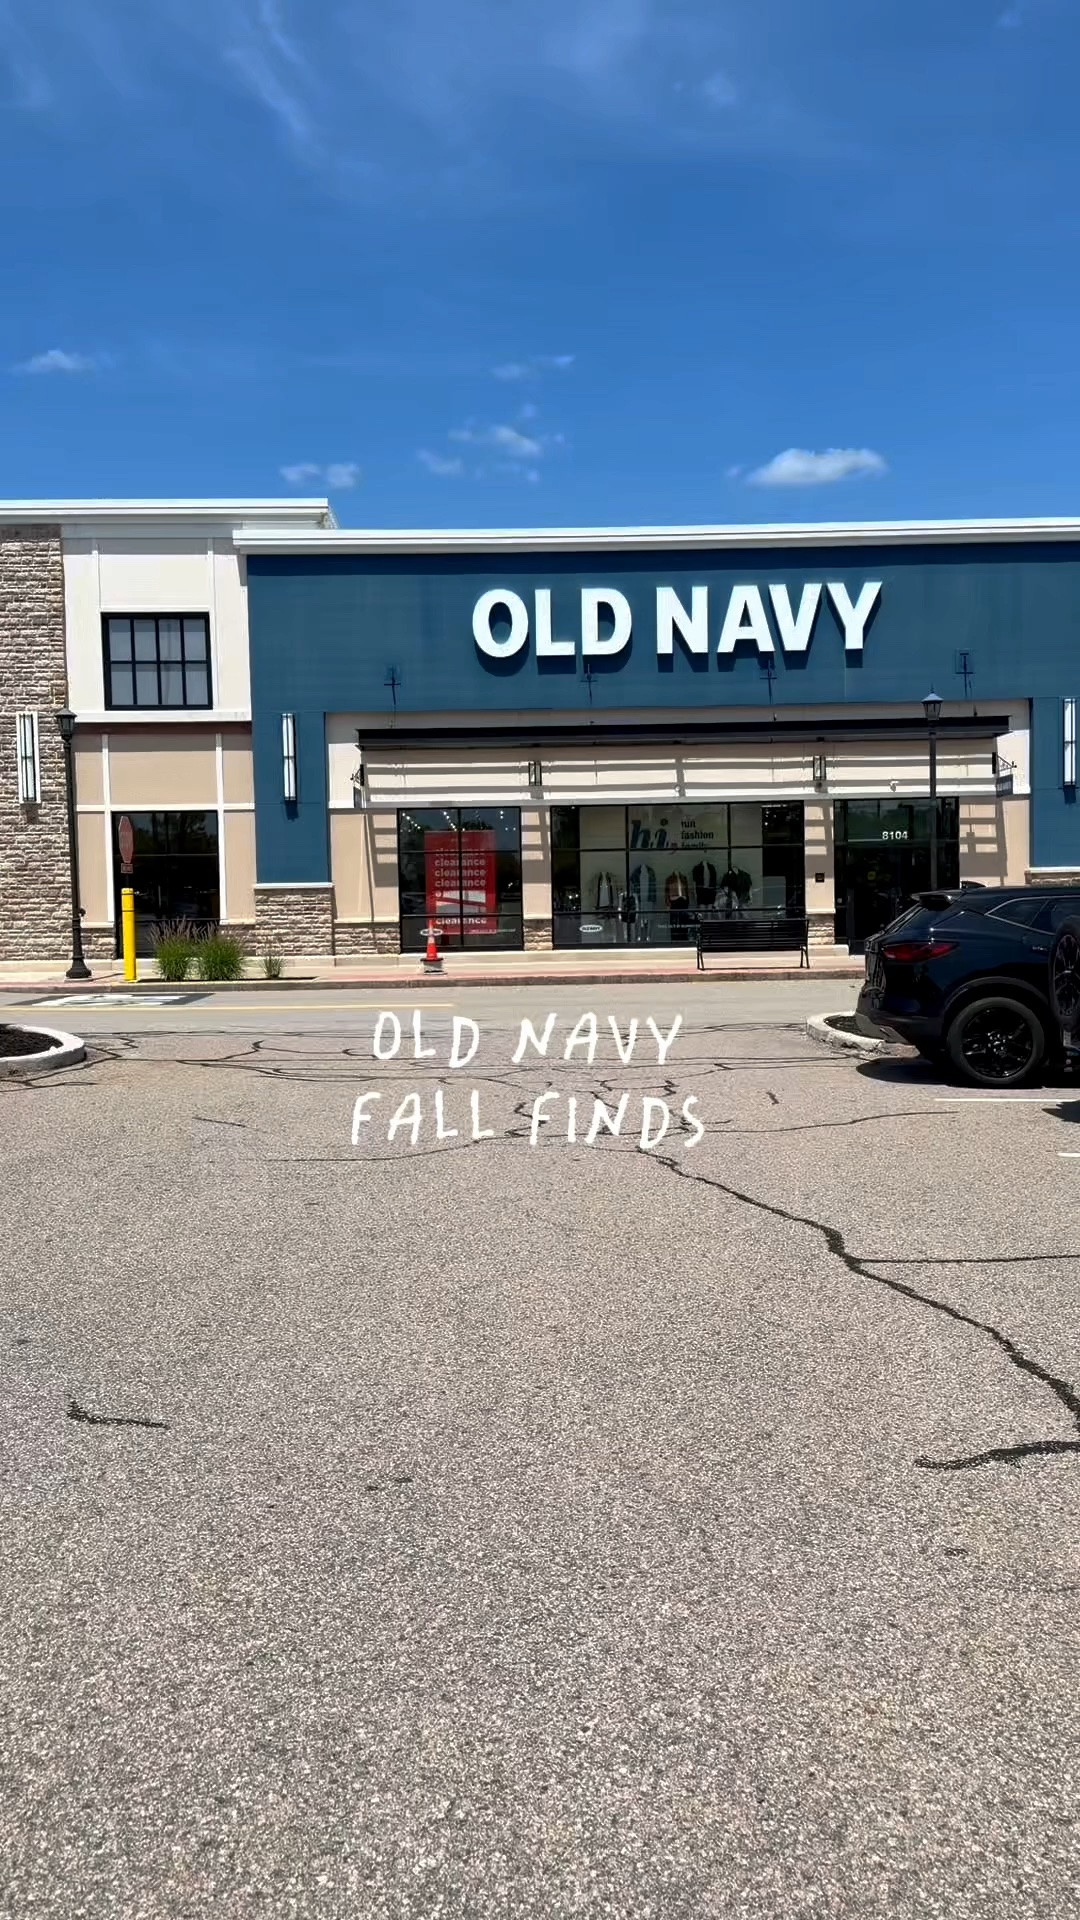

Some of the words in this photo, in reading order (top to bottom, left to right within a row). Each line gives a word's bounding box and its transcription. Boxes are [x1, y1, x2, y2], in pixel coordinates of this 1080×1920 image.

[472, 587, 632, 658] OLD
[656, 580, 882, 654] NAVY
[680, 830, 714, 839] fashion
[882, 830, 908, 840] 8104
